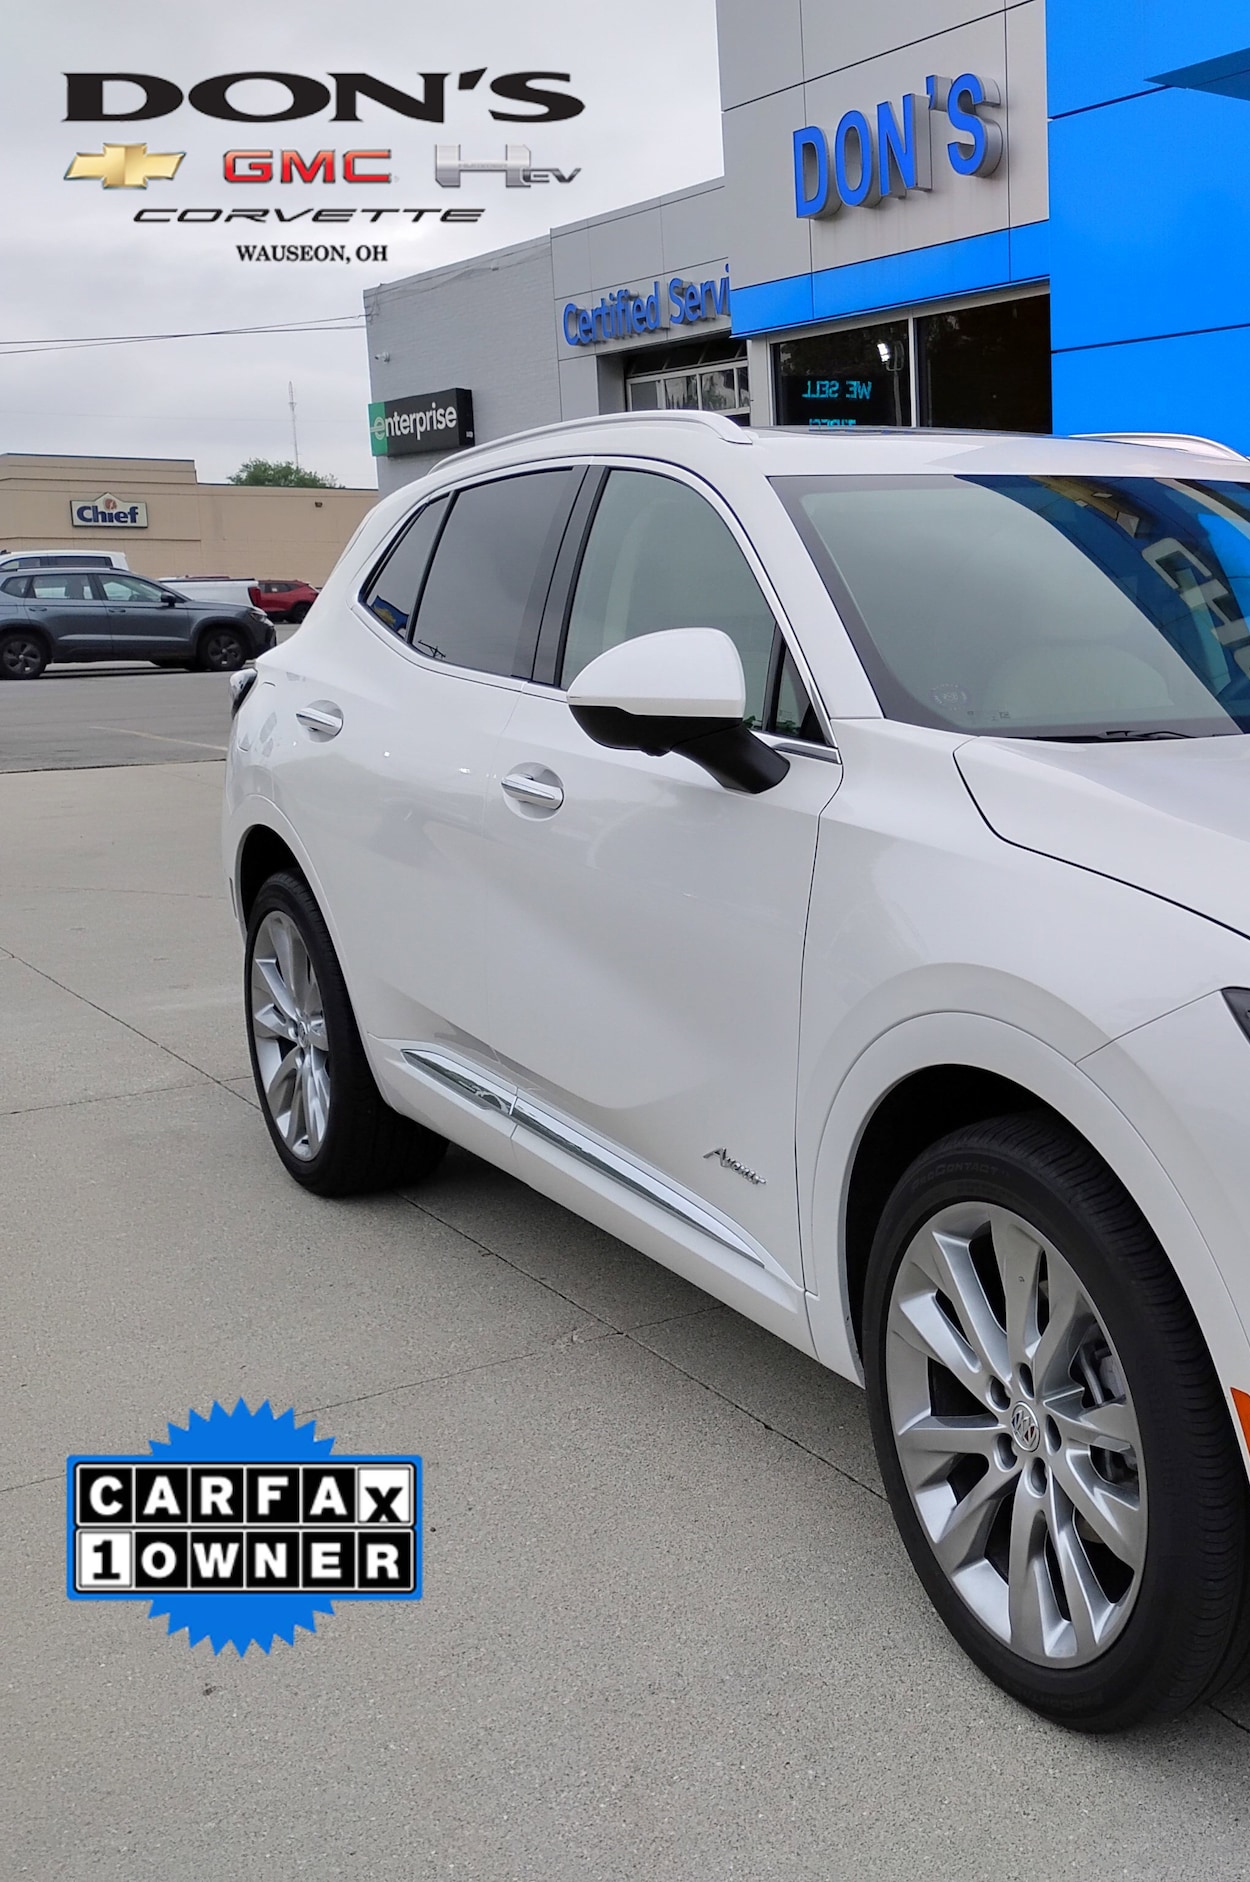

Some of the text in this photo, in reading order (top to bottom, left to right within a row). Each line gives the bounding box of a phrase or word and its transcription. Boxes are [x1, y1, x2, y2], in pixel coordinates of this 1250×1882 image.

[793, 73, 1001, 219] DON'S
[563, 281, 660, 346] Certified
[371, 402, 457, 440] enterprise
[76, 505, 139, 524] Chief
